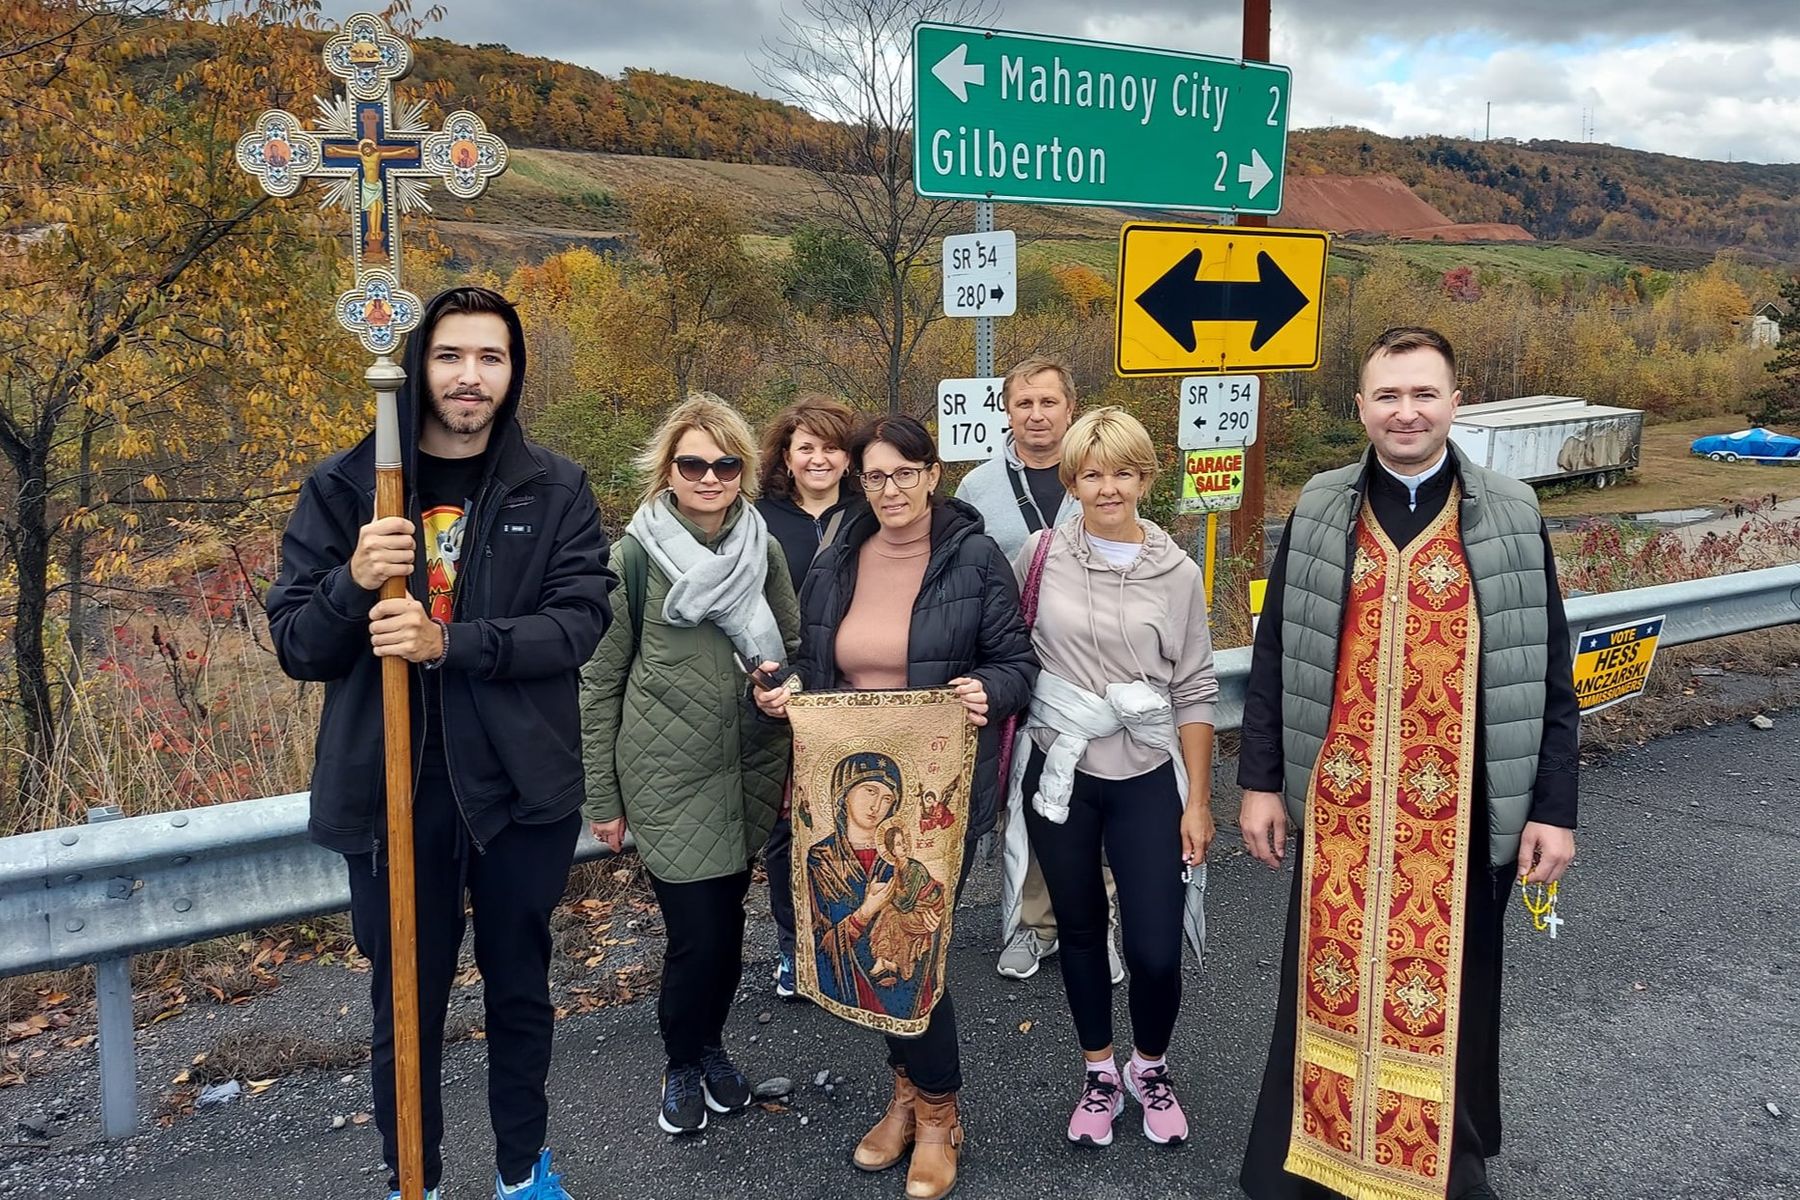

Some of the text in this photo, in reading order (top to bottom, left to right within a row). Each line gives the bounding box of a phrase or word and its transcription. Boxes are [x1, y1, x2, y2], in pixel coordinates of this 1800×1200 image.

[1001, 55, 1281, 132] Mahanoy City 2
[932, 126, 1229, 192] Gilberton 2
[952, 246, 998, 270] SR 54
[957, 284, 986, 308] 280
[943, 391, 1006, 415] SR 40
[1188, 383, 1251, 405] SR 54
[1218, 411, 1249, 431] 290
[952, 423, 987, 445] 170
[1187, 455, 1242, 474] GARAGE
[1196, 474, 1231, 493] SALE
[1610, 628, 1637, 645] VOTE
[1593, 642, 1641, 673] HESS
[1575, 661, 1648, 694] ANCZARSKI
[1578, 679, 1643, 709] OMMISSIONERS
